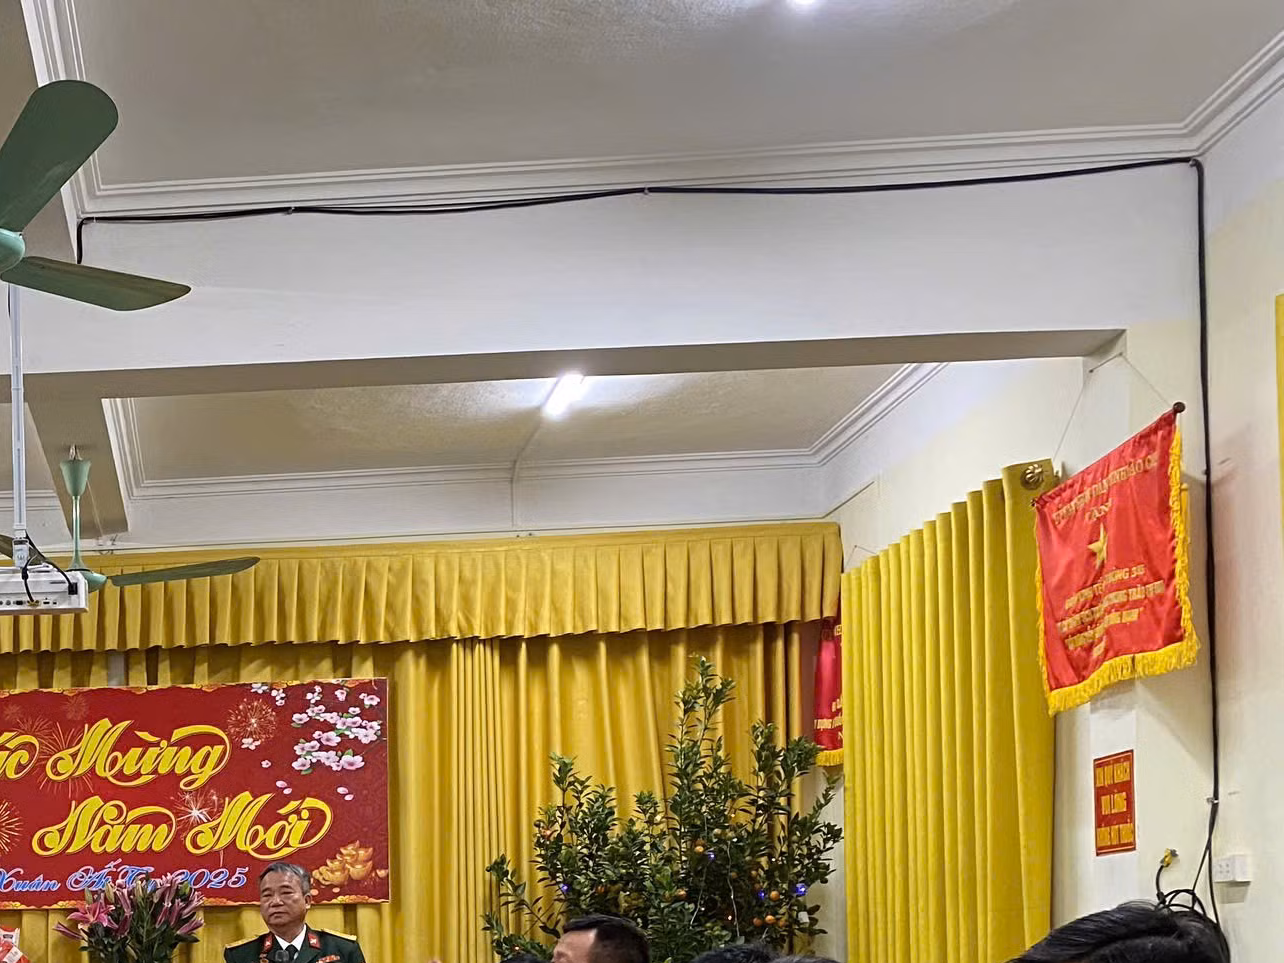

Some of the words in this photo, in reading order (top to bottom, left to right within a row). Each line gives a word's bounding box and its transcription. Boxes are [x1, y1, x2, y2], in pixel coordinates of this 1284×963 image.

[45, 717, 232, 791] Mừng
[31, 794, 178, 857] Năm
[184, 789, 334, 862] Mới
